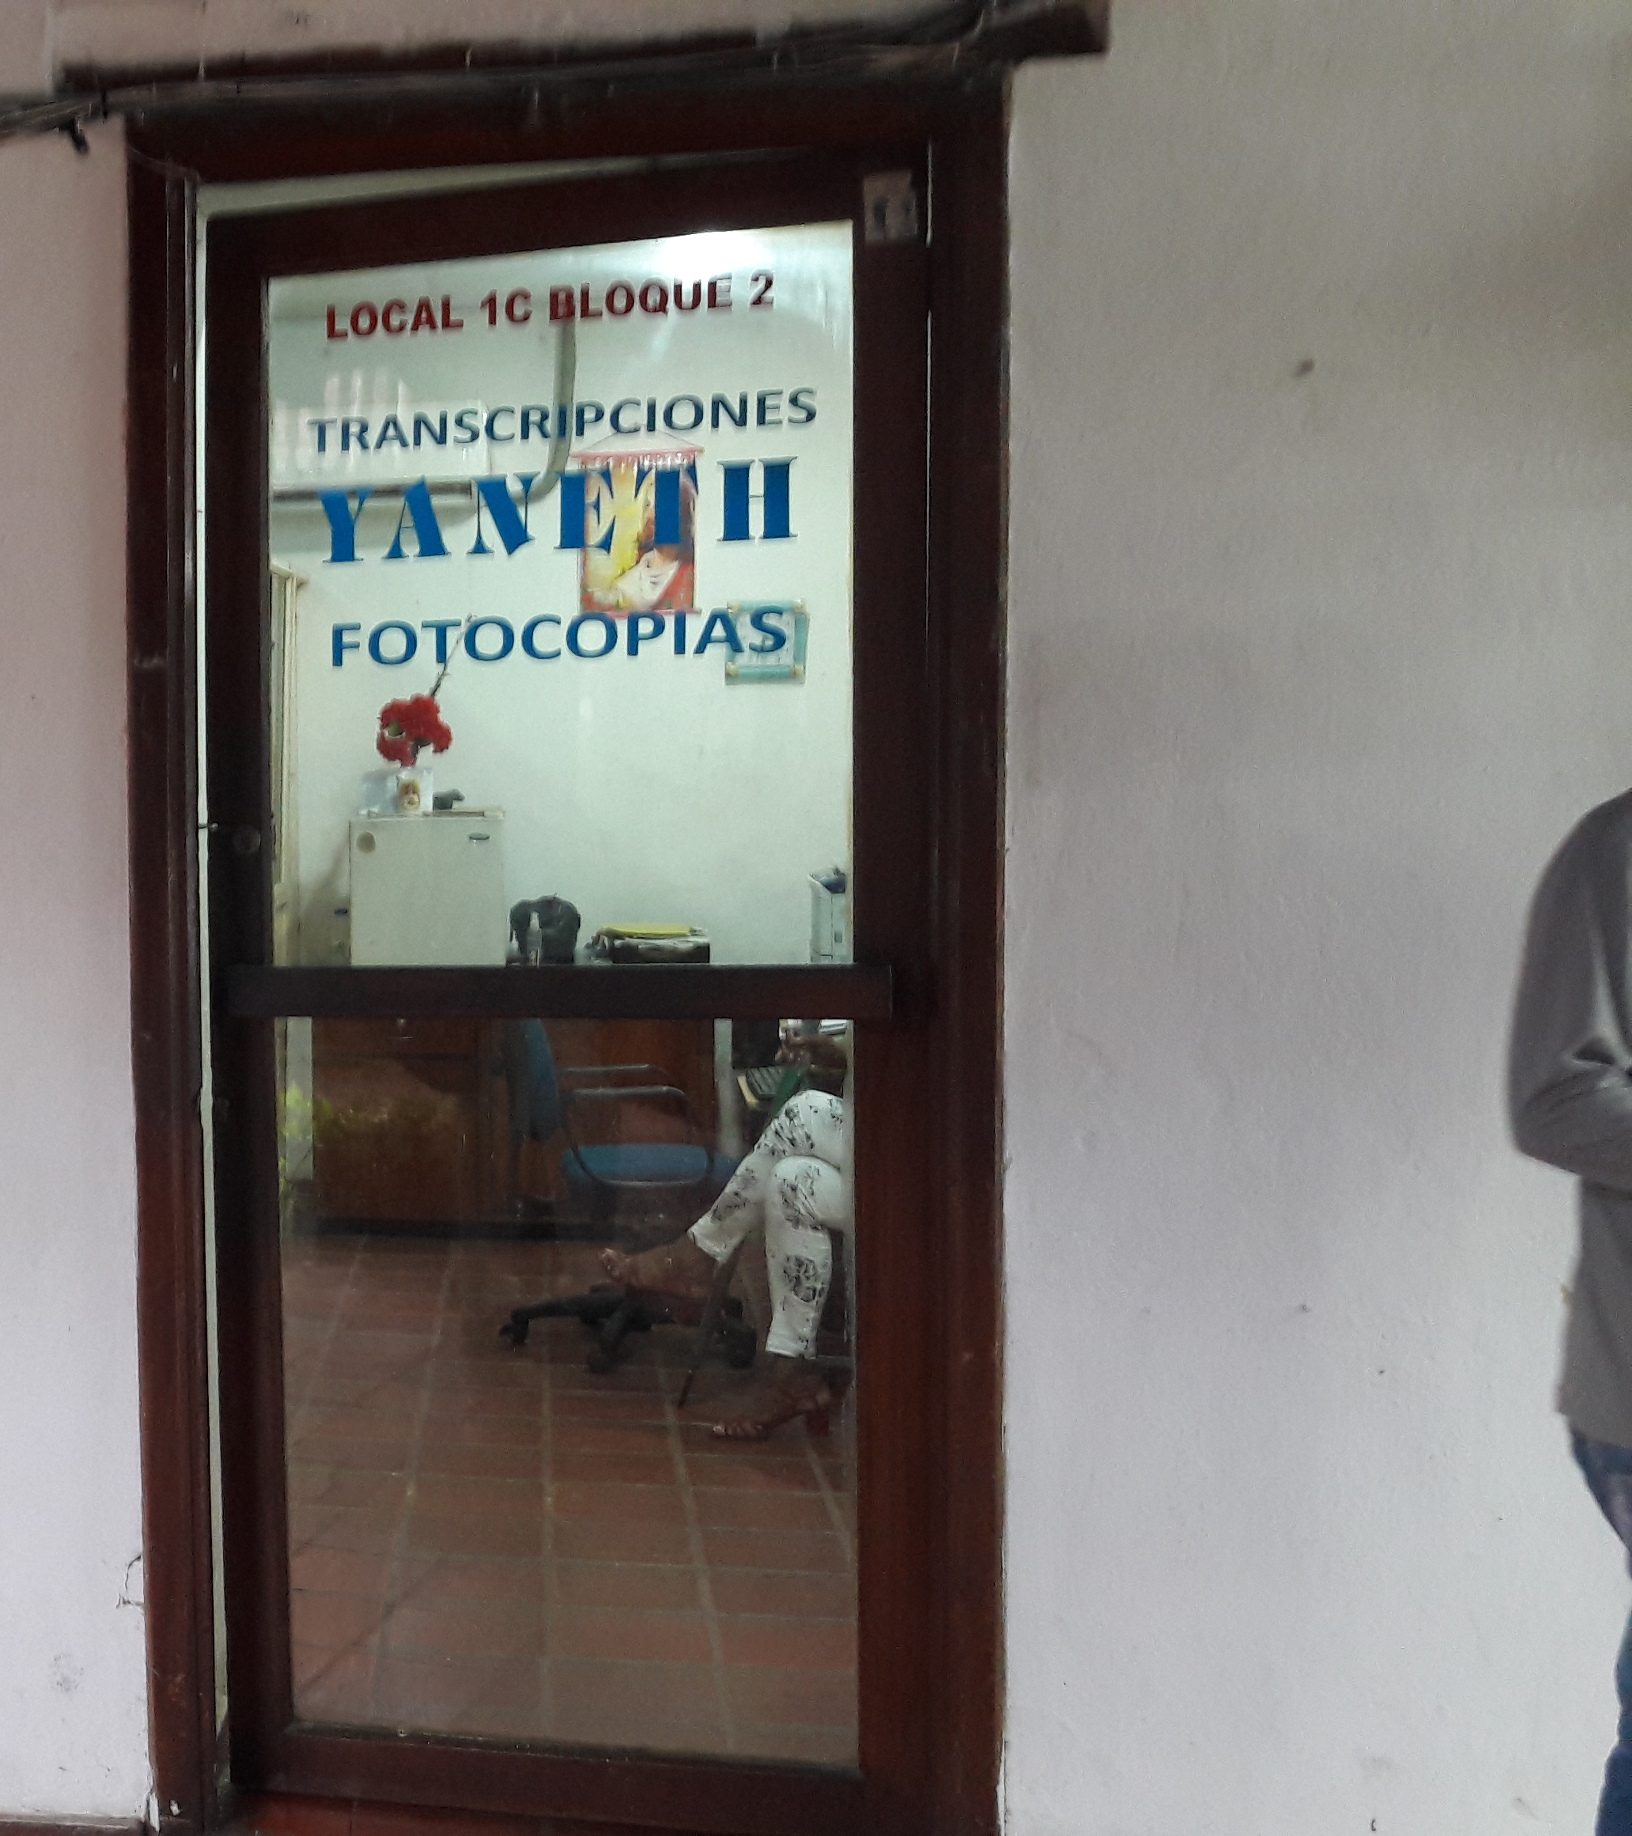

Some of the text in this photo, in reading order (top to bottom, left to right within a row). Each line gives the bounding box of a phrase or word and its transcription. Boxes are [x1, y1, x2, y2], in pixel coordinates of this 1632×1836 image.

[325, 269, 776, 340] LOCAL 1C BLOQUE 2
[307, 386, 818, 455] TRANSCRIPCIONES
[315, 456, 798, 564] YANETH
[331, 604, 787, 668] FOTOCOPIAS
